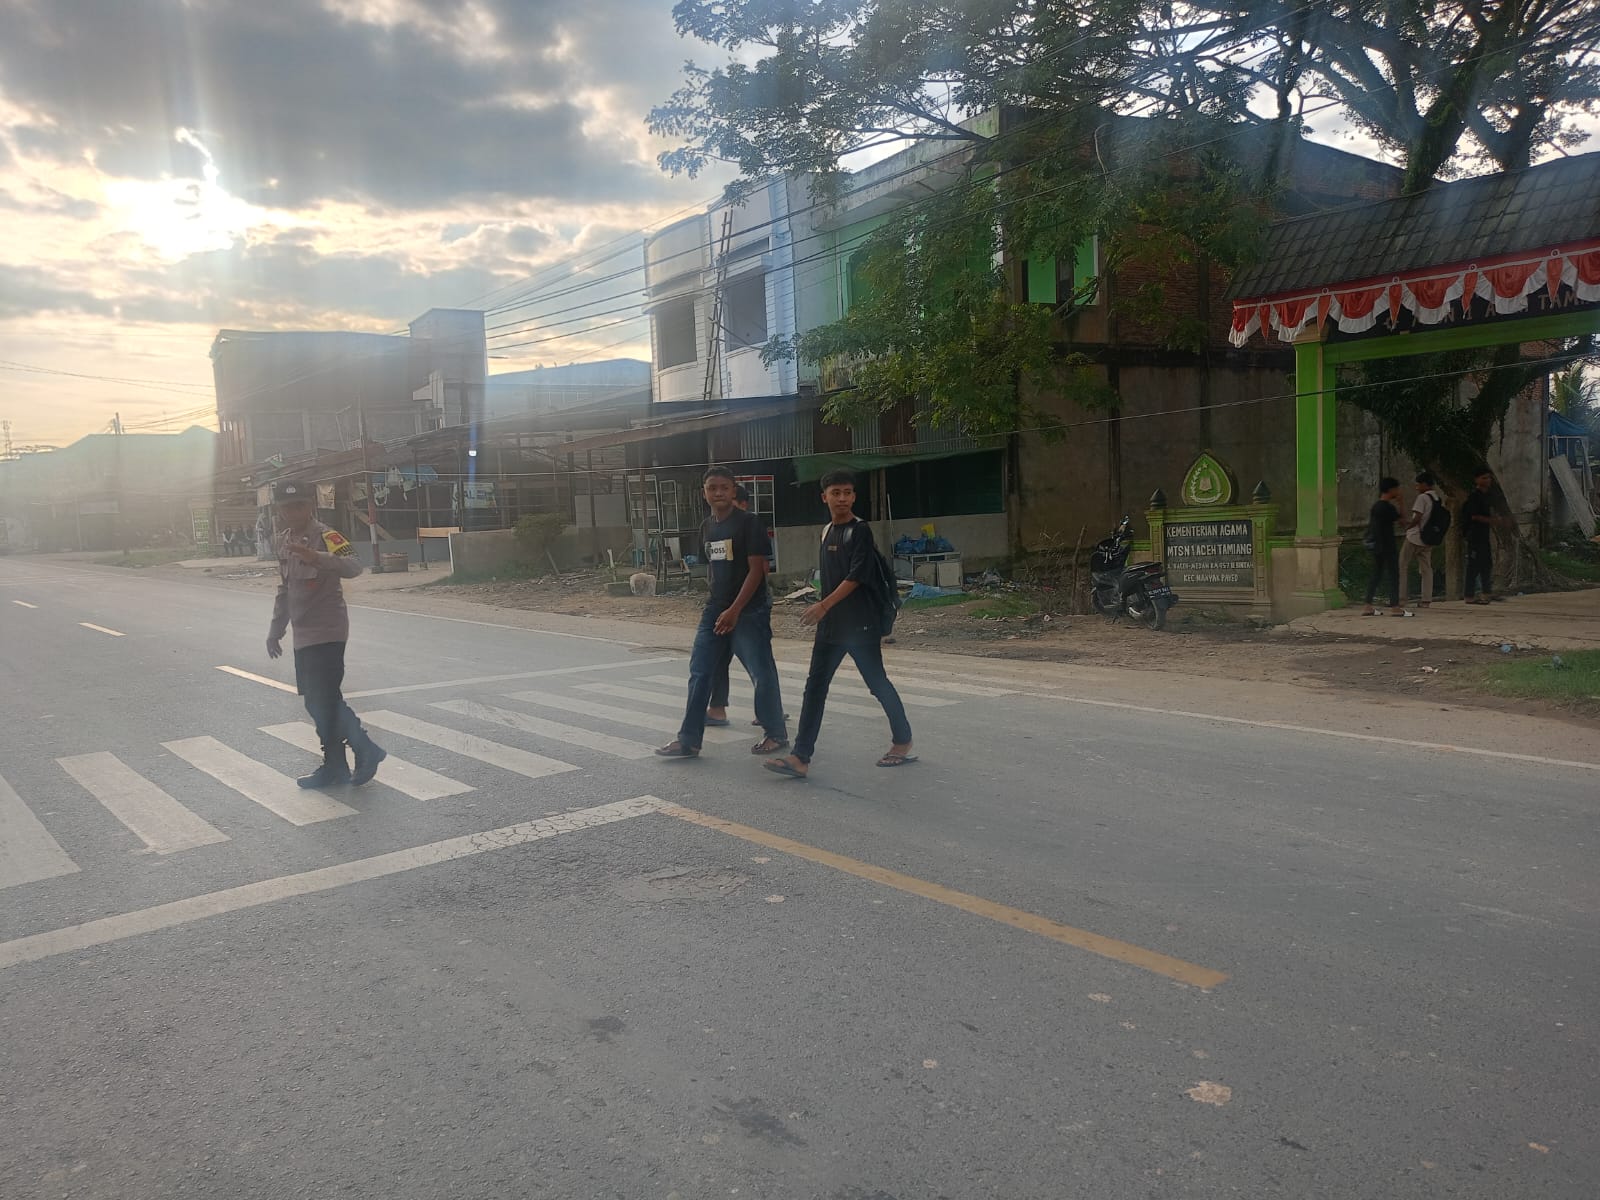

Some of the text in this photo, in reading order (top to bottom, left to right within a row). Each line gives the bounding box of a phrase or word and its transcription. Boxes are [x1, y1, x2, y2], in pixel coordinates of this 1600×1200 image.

[1166, 523, 1248, 537] KEMENTERIAN AGAMA
[1196, 544, 1216, 556] ACEH
[1217, 543, 1252, 555] TAMIANG
